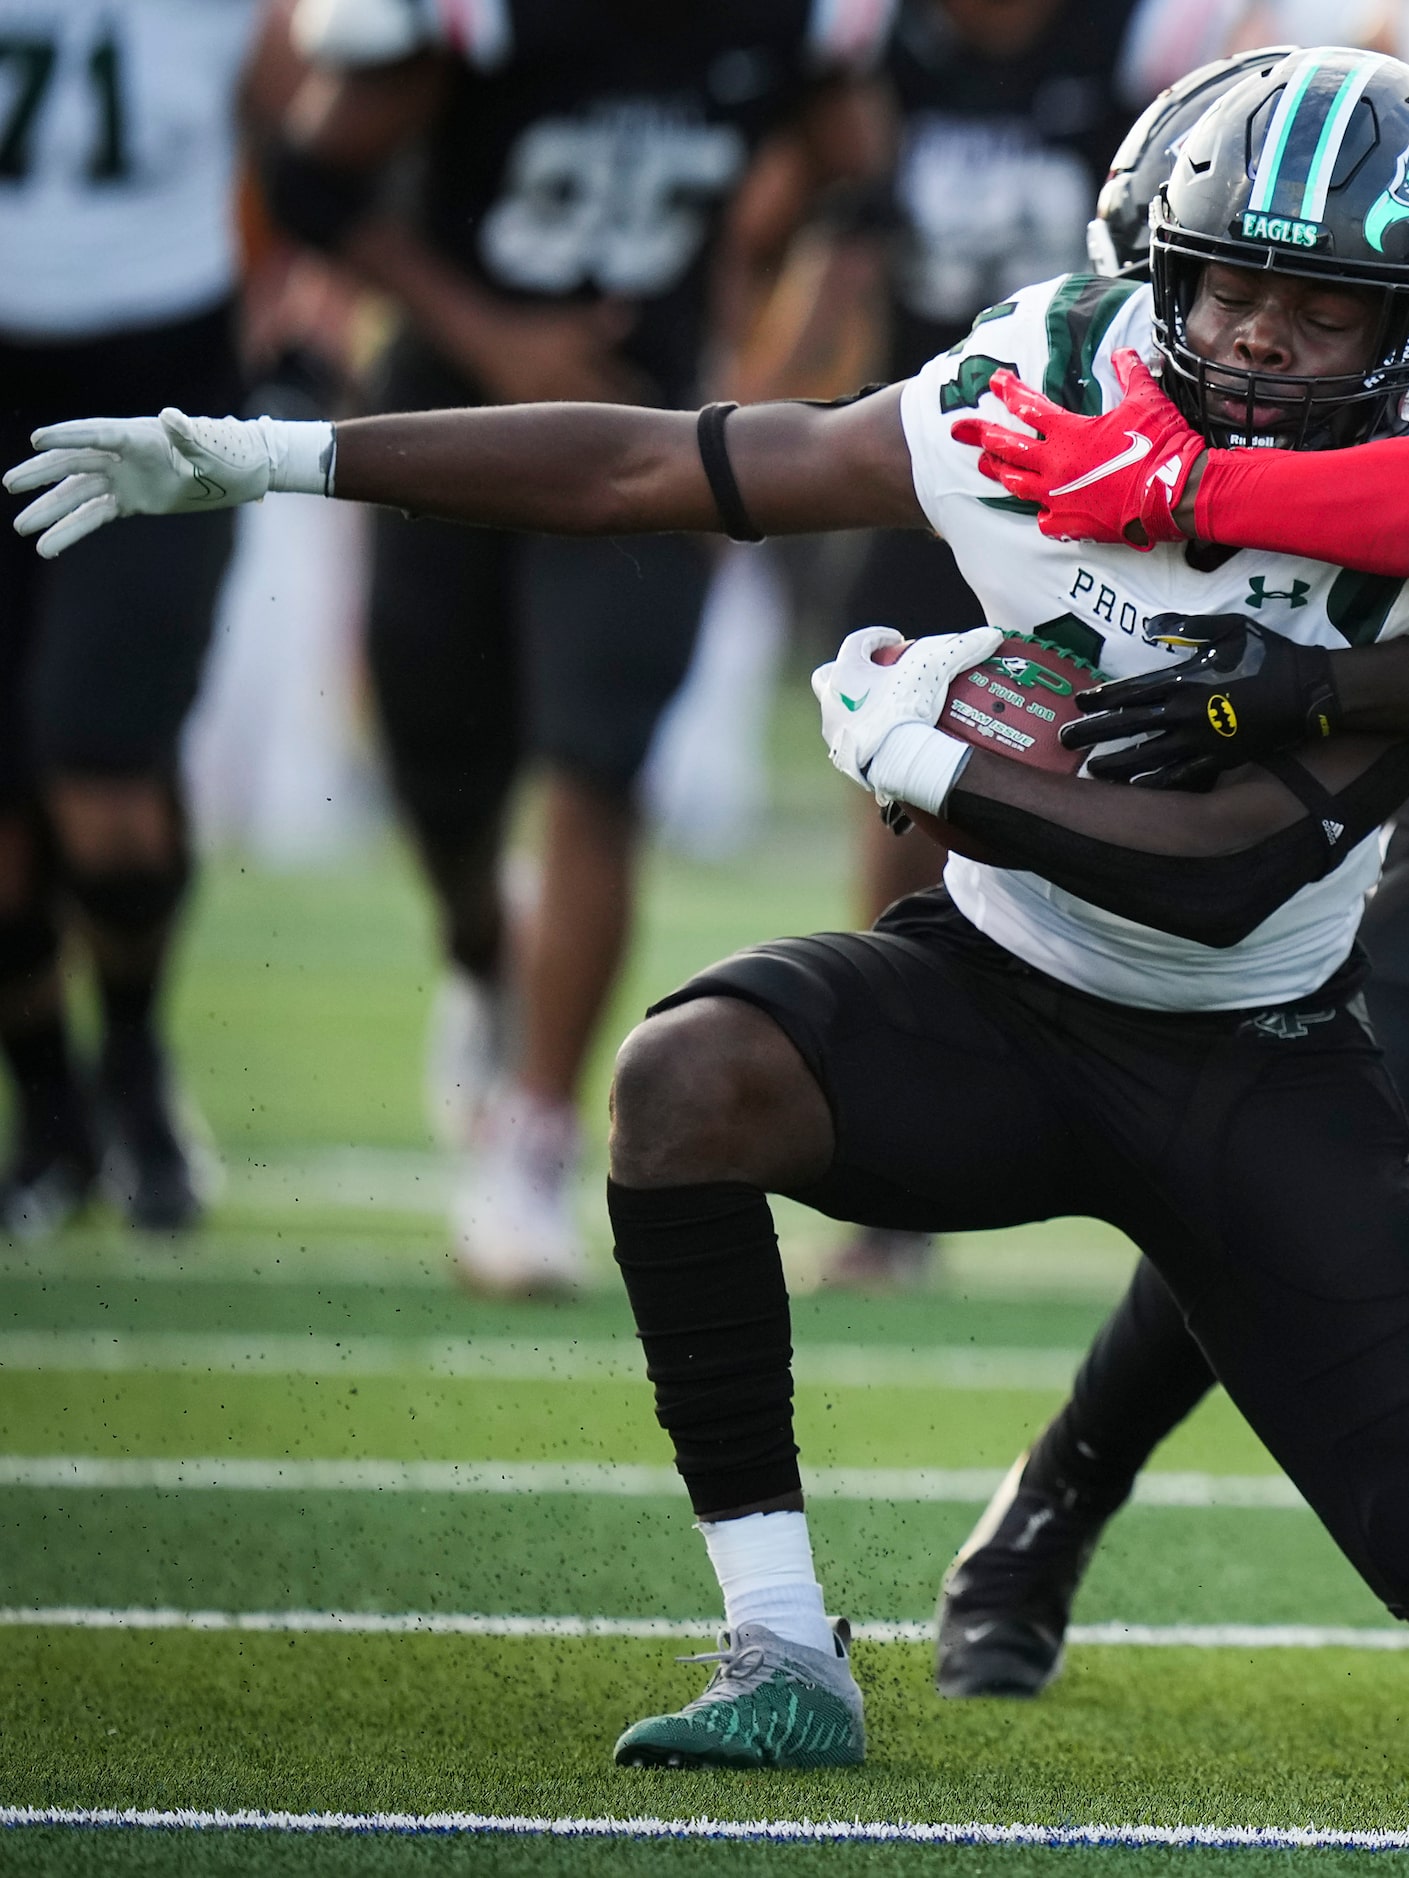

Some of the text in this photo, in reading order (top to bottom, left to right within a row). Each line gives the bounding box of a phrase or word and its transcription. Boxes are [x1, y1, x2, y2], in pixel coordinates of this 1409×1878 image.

[1241, 212, 1319, 249] EAGLES
[968, 671, 1056, 722] DO YOUR JOB
[950, 699, 994, 727] TEAM
[986, 721, 1036, 748] ISSUE
